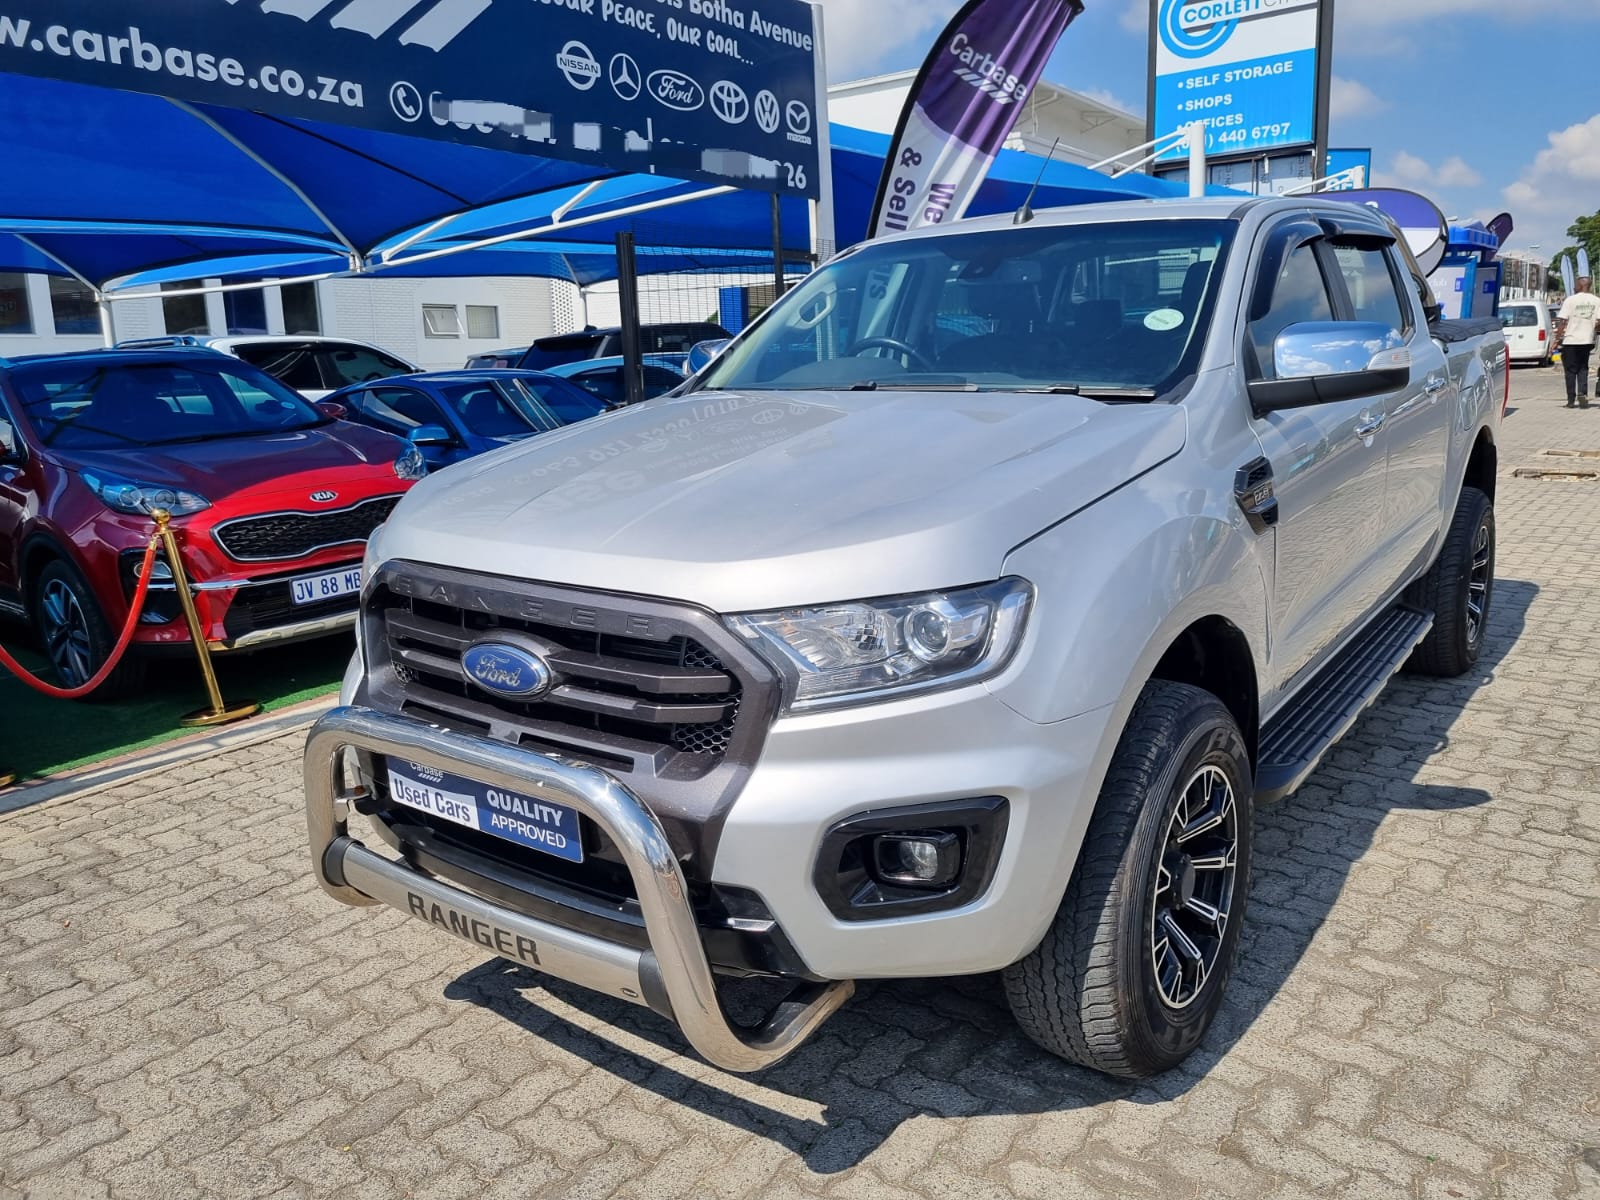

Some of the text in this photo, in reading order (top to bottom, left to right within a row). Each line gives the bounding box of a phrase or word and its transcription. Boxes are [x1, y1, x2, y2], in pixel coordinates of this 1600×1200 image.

[666, 17, 701, 46] OUR
[690, 0, 813, 51] Botha Avenue
[559, 57, 599, 74] NISSAN
[950, 33, 1027, 101] Carbase
[1186, 60, 1294, 89] SELF STORAGE
[658, 76, 694, 104] Ford
[1185, 94, 1233, 111] SHOPS
[1218, 129, 1247, 144] 440
[1251, 122, 1291, 140] 6797
[885, 147, 922, 231] & Sell
[924, 184, 957, 224] We
[315, 490, 334, 501] KIA
[296, 581, 313, 601] JV
[321, 576, 339, 595] 88
[475, 653, 521, 687] Ford
[394, 777, 563, 827] Used Cars QUALITY
[491, 813, 567, 849] APPROVED
[407, 891, 541, 966] RANGER
